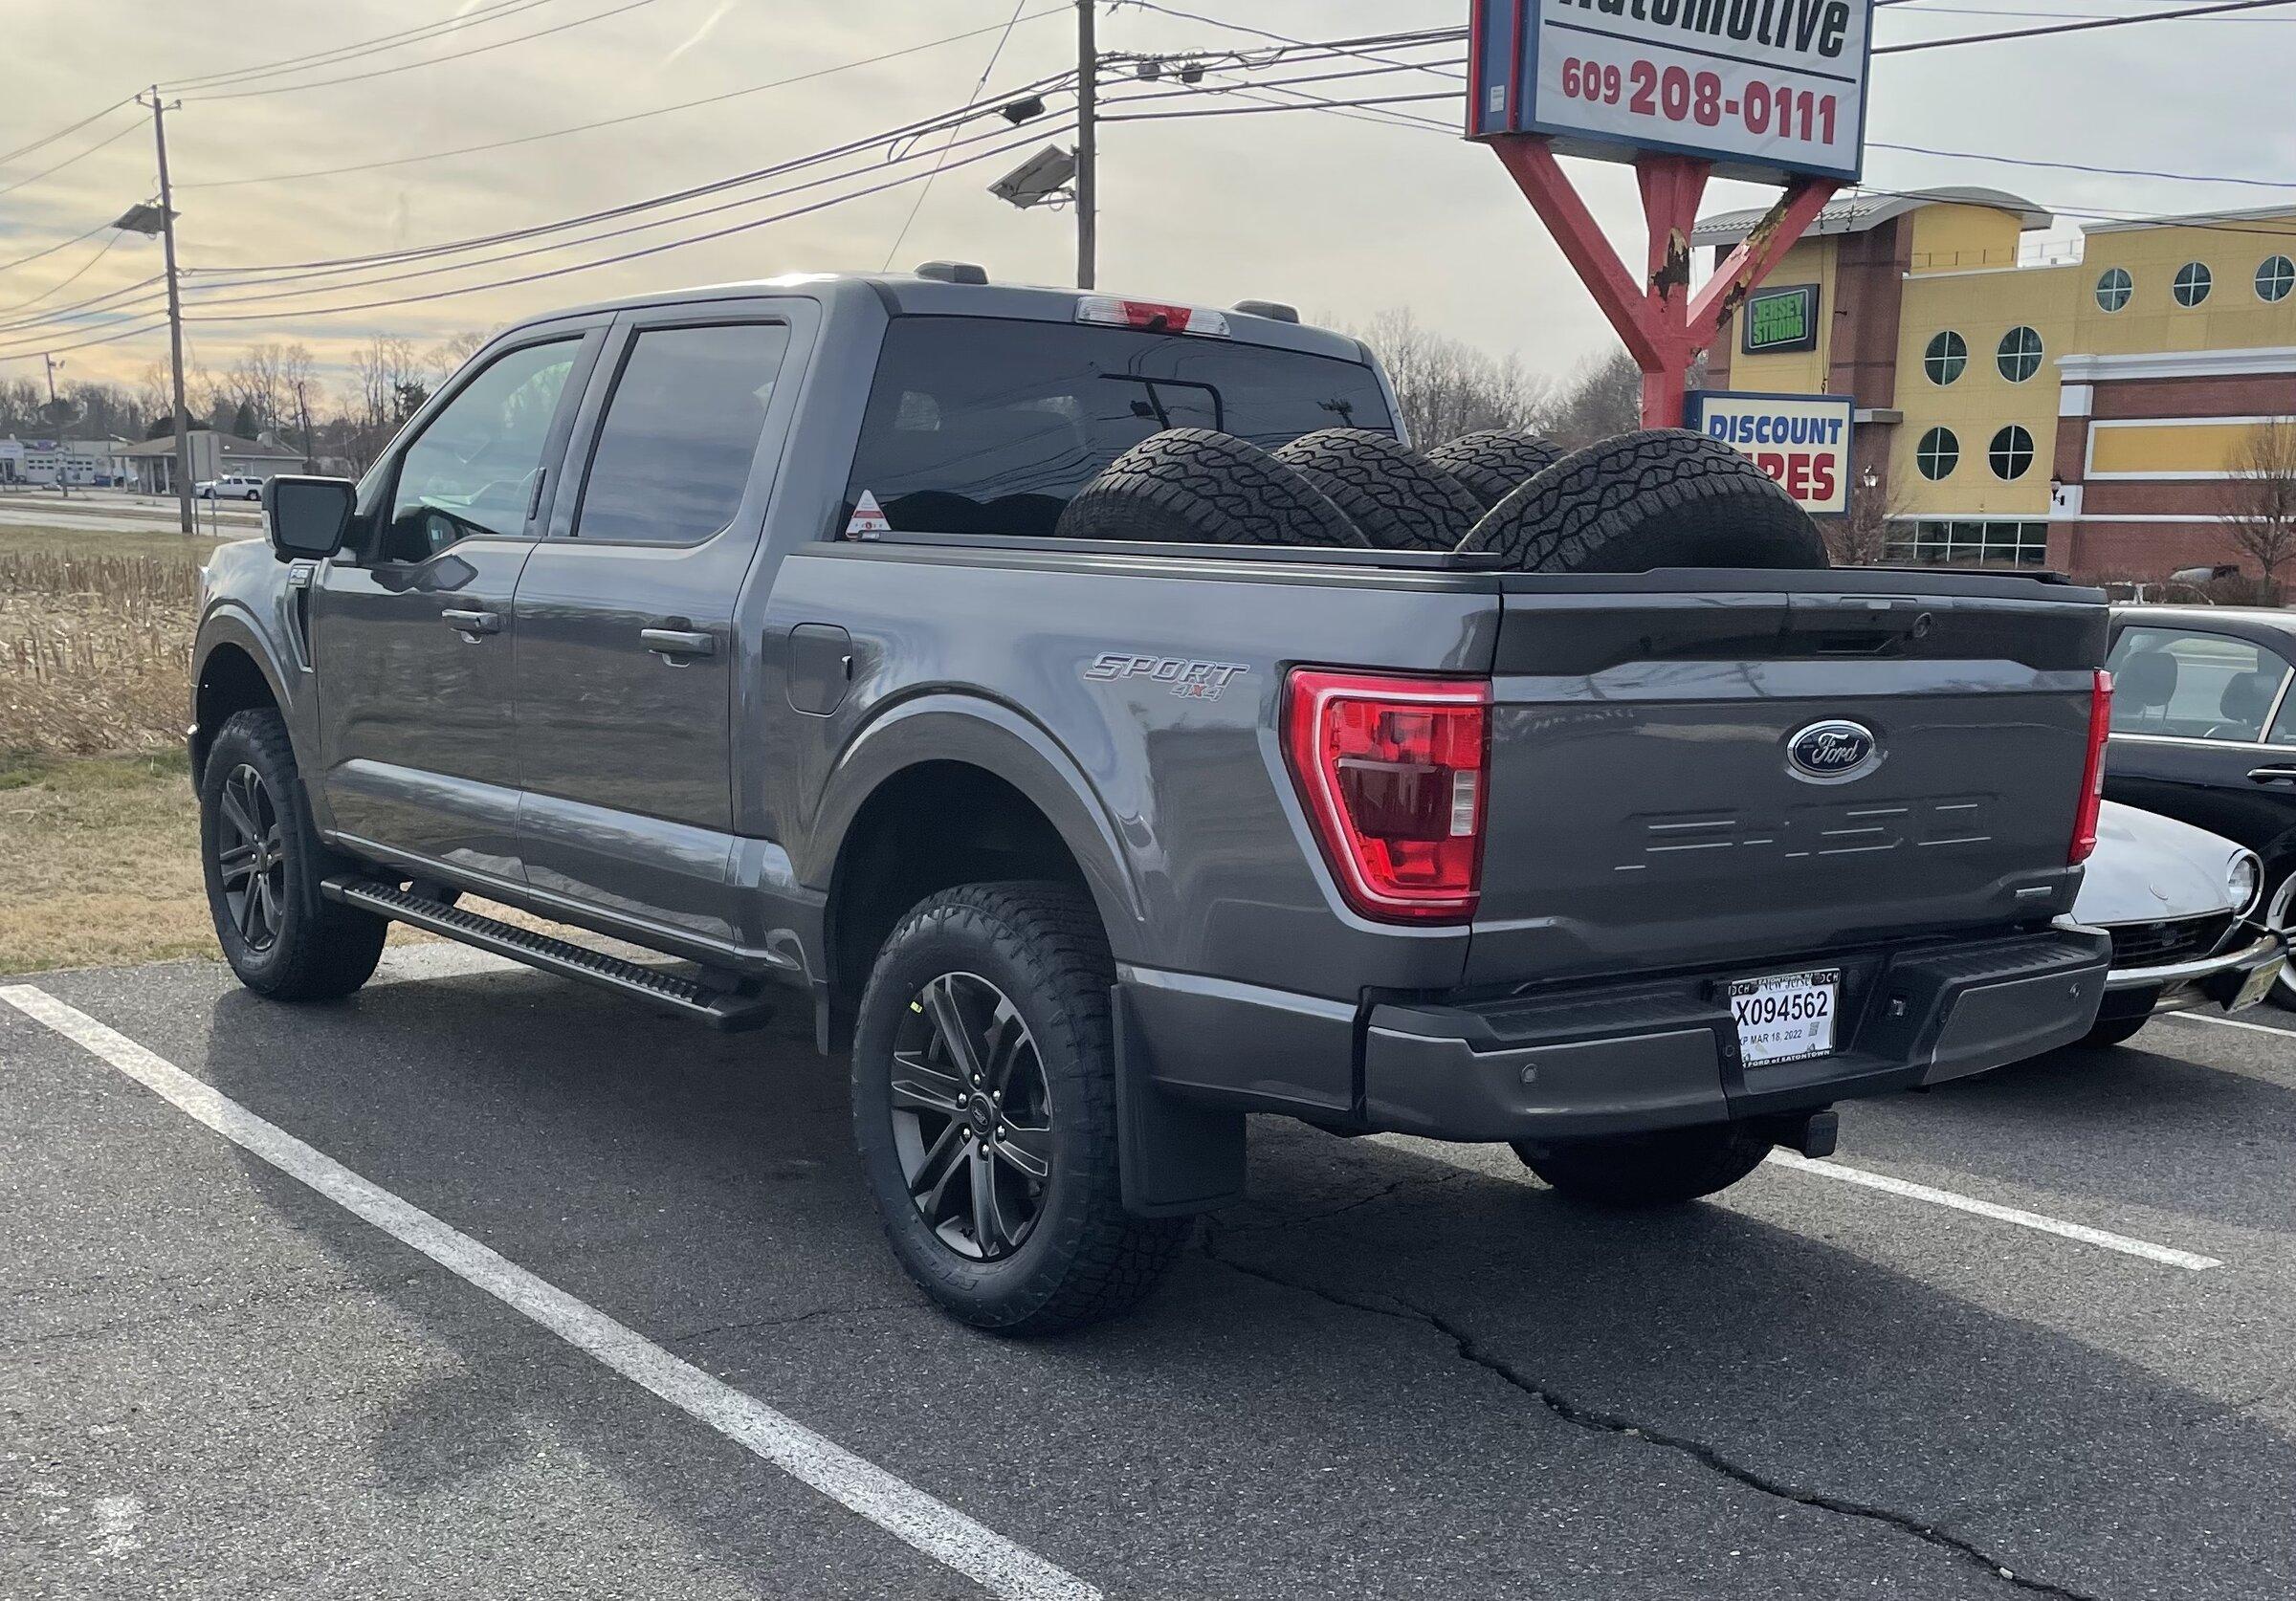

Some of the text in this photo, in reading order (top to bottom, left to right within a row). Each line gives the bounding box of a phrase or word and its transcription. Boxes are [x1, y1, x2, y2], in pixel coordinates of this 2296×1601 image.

[1559, 0, 1850, 58] motive
[1562, 57, 1837, 144] 609 208-0111
[1754, 293, 1804, 323] JERSEY
[1754, 316, 1803, 344] STRONG
[1709, 414, 1843, 445] DISCOUNT
[1741, 452, 1836, 501] RES
[1083, 651, 1250, 687] SPORT
[1811, 732, 1860, 764] Ford
[1735, 990, 1828, 1027] X094562
[1750, 1033, 1769, 1044] MAR
[1784, 1029, 1802, 1041] 2022
[1748, 1060, 1770, 1068] FORD
[1781, 1050, 1830, 1062] EATONTOWN
